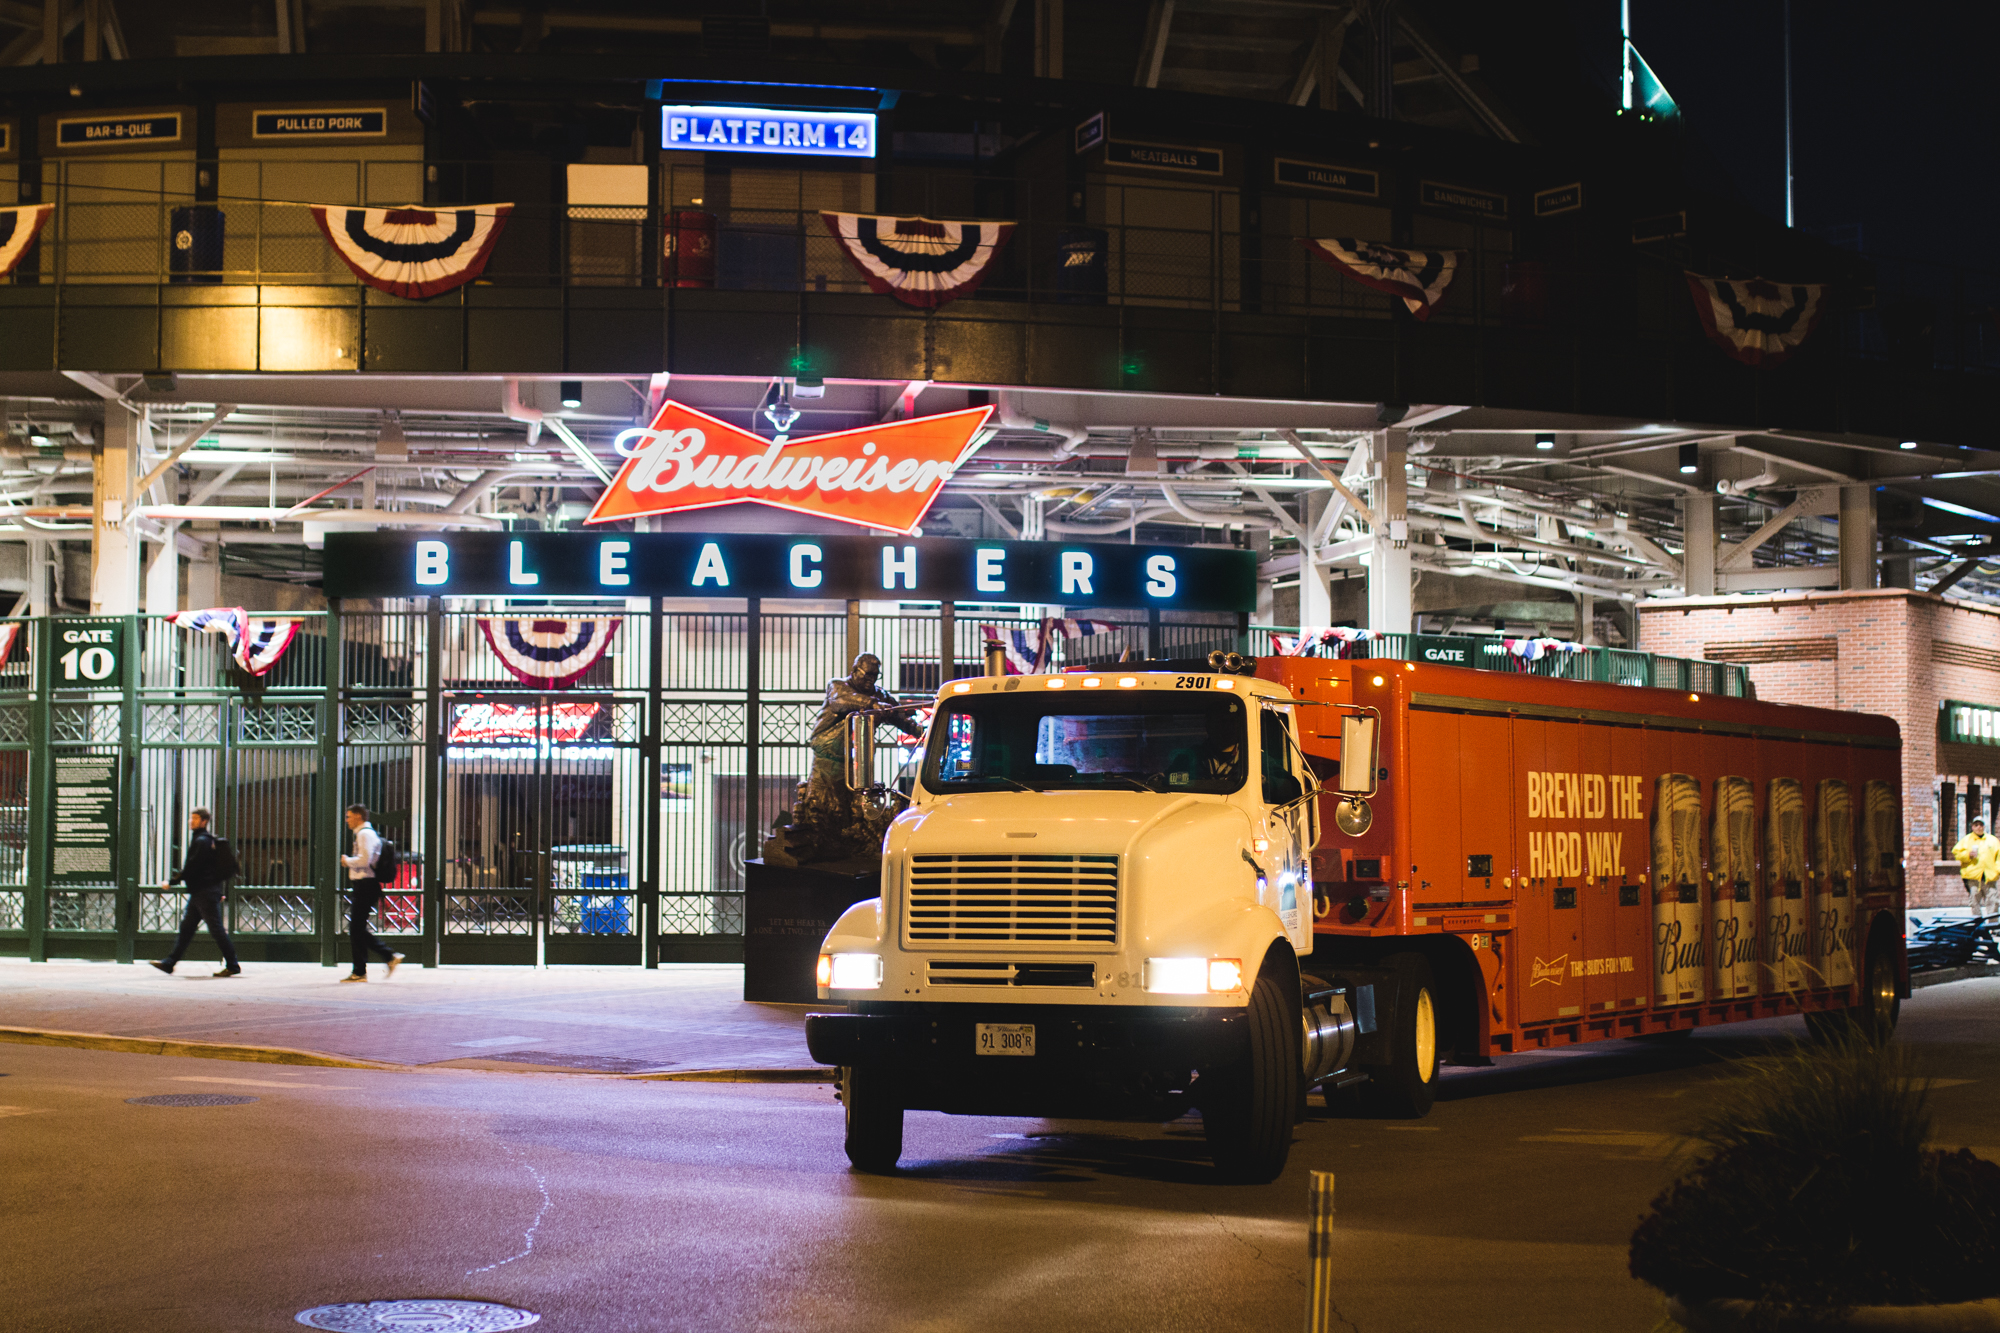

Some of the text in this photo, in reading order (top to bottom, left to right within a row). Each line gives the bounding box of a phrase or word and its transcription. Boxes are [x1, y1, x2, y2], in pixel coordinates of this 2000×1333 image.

[85, 122, 152, 138] BAR-B-QUE
[276, 116, 363, 130] PULLED PORK
[670, 117, 868, 149] PLATFORM 14
[1130, 149, 1198, 167] MEATBALLS
[1307, 170, 1347, 186] ITALIAN
[1433, 190, 1494, 211] SANDWICHES
[1544, 193, 1572, 207] ITALIAN
[613, 427, 955, 494] Budweiser
[414, 540, 1177, 599] BLEACHERS
[62, 629, 114, 644] GATE
[1425, 647, 1465, 662] GATE
[60, 647, 115, 681] 10
[1175, 676, 1211, 689] 2901
[1527, 771, 1644, 819] BREWED THE
[1528, 831, 1626, 878] HARD WAY.
[981, 1032, 995, 1049] 91
